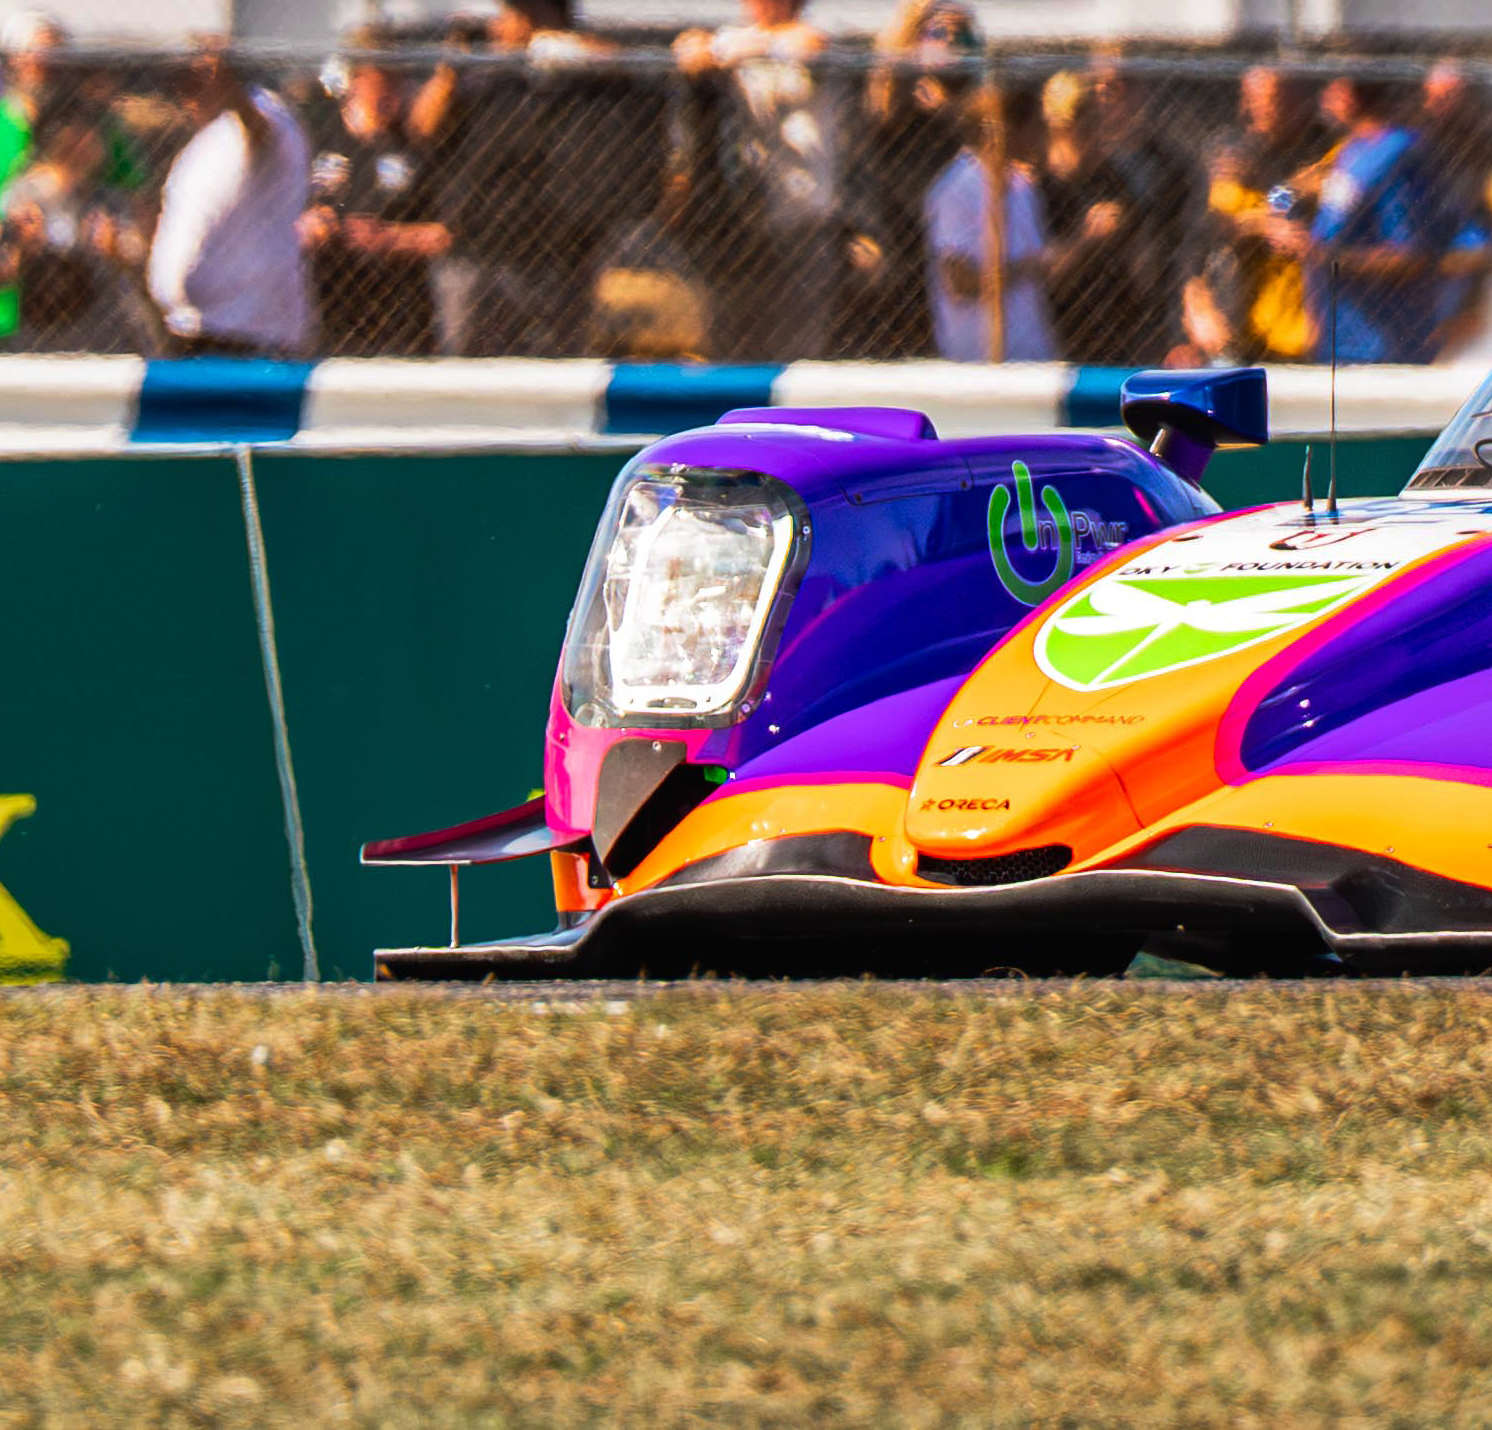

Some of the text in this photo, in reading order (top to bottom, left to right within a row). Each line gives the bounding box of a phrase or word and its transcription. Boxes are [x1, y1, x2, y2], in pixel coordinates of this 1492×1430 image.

[1220, 560, 1401, 573] FOUNDATION
[978, 747, 1077, 763] IMSA
[937, 798, 1011, 811] ORECA
